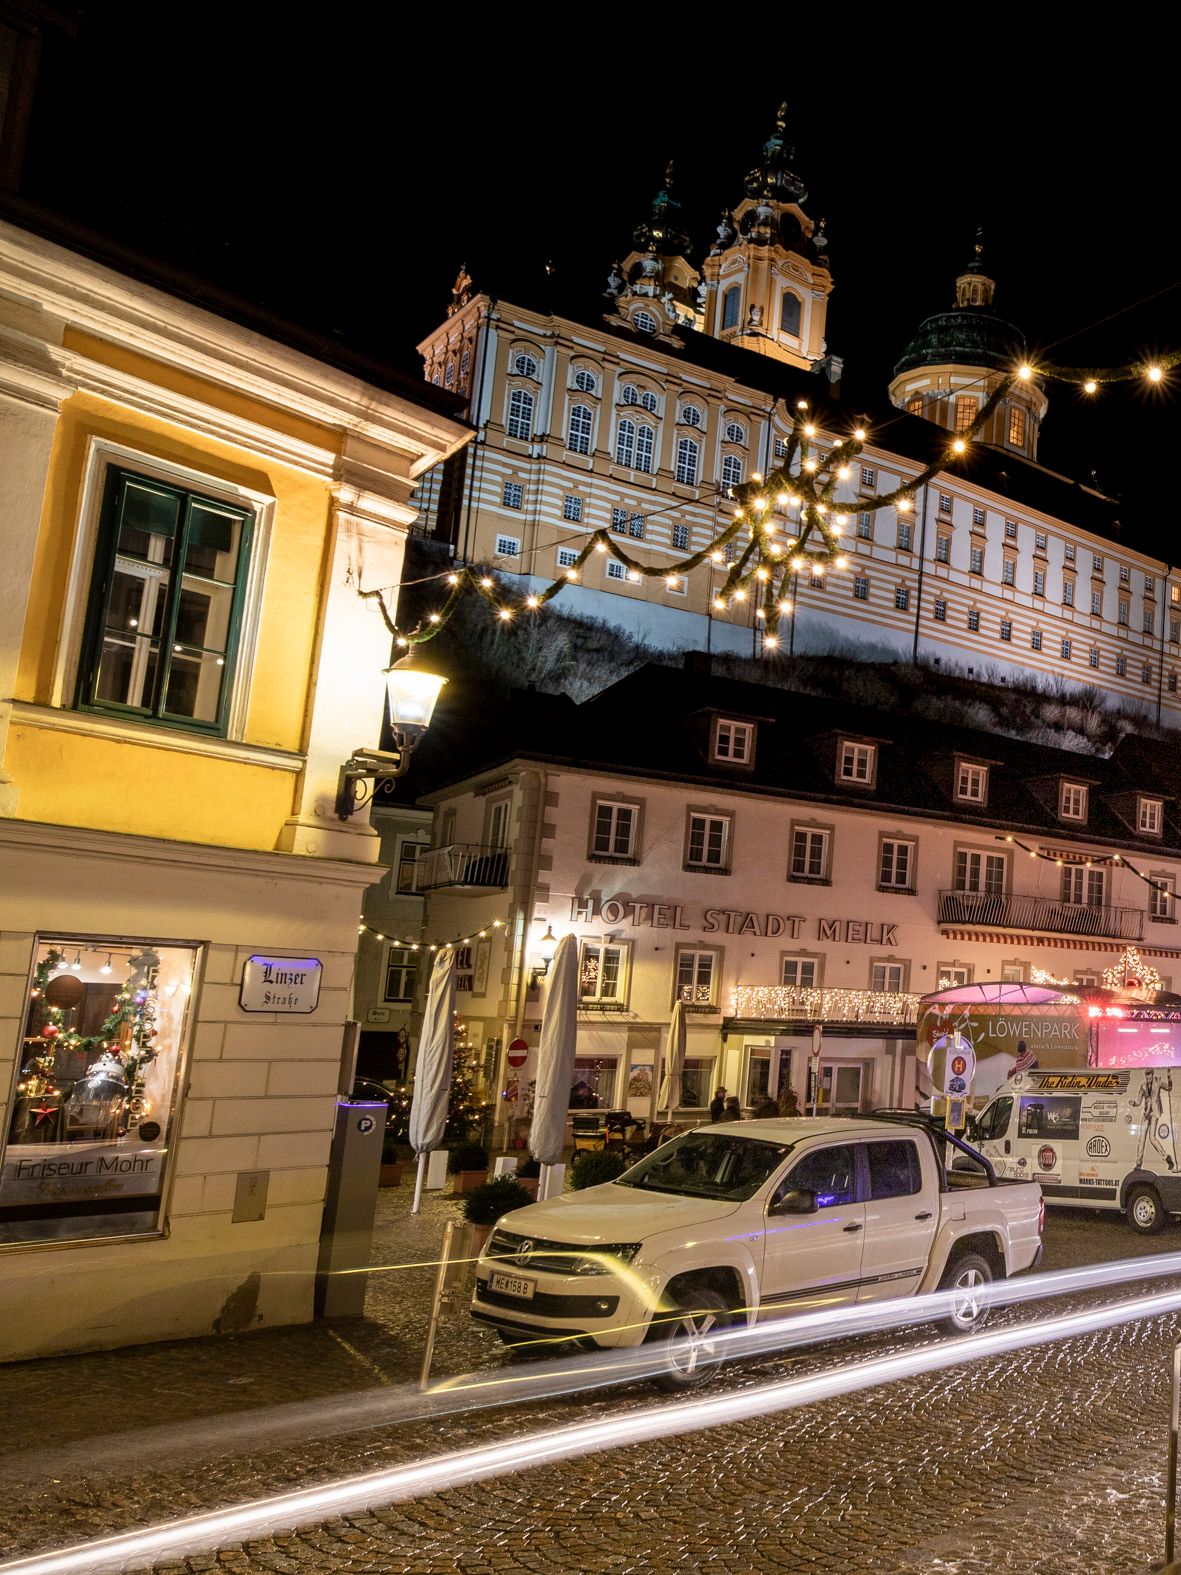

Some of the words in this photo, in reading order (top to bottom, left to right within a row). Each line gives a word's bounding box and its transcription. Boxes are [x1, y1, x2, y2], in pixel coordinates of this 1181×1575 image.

[569, 896, 690, 931] HOTEL
[703, 907, 805, 939] STADT
[818, 918, 899, 946] MELK
[262, 962, 306, 987] Linzer
[988, 1017, 1080, 1040] LÖWENPARK
[955, 1060, 963, 1072] H
[1039, 1075, 1055, 1088] The
[1088, 1138, 1109, 1154] ARDEX
[16, 1157, 93, 1178] Friseur
[98, 1153, 154, 1175] Mohr
